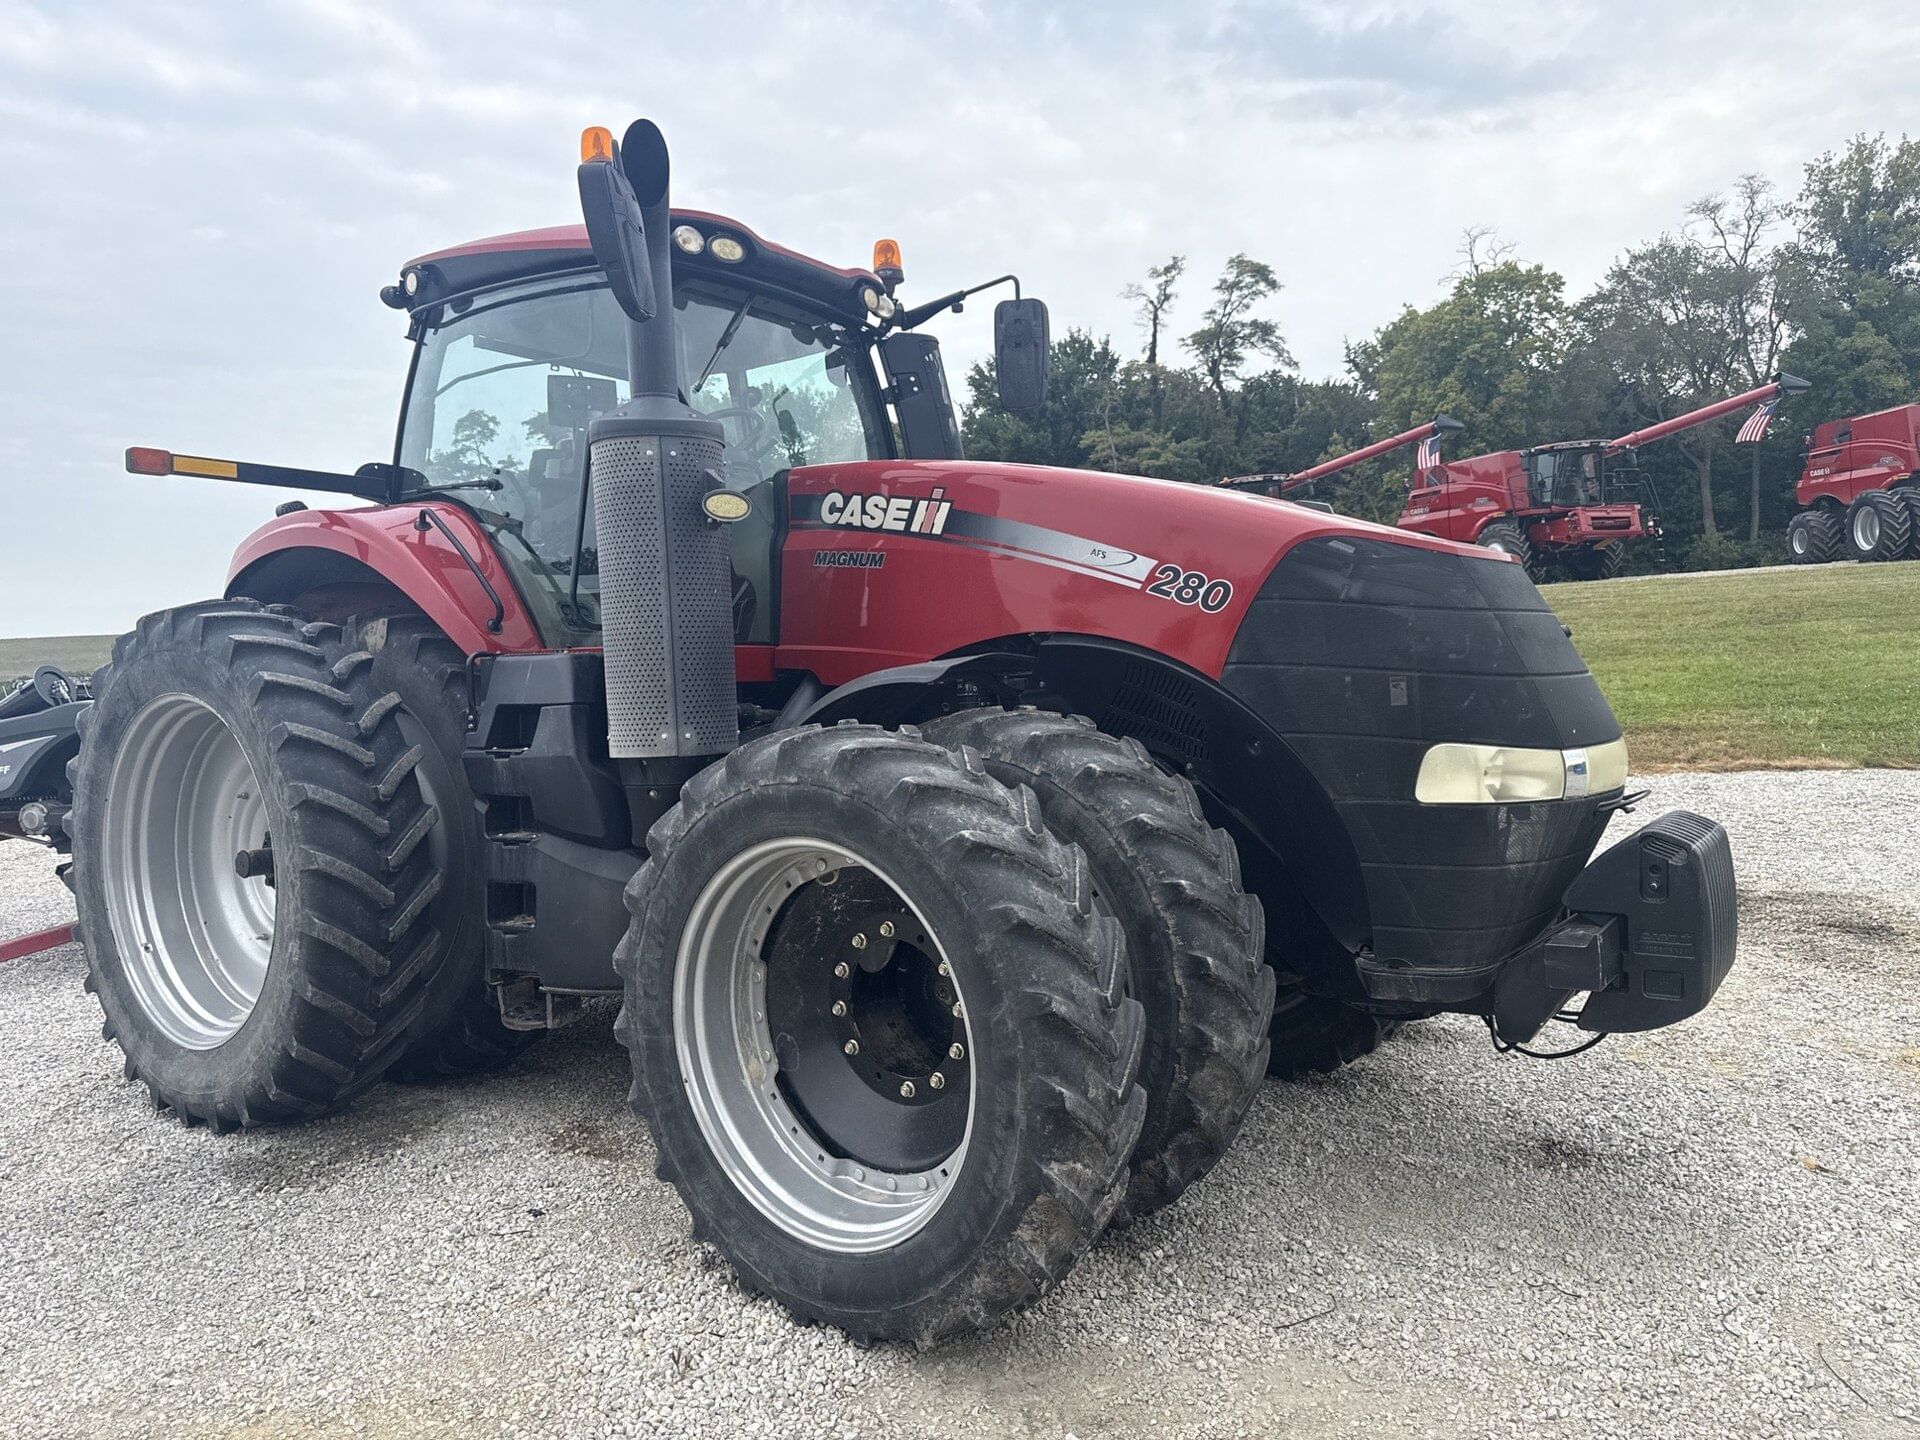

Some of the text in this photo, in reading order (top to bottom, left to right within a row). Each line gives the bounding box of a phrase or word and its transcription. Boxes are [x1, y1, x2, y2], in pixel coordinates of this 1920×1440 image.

[821, 492, 913, 531] CASE
[813, 551, 886, 568] MAGNUM
[1090, 548, 1107, 560] AFS
[1145, 563, 1234, 614] 280
